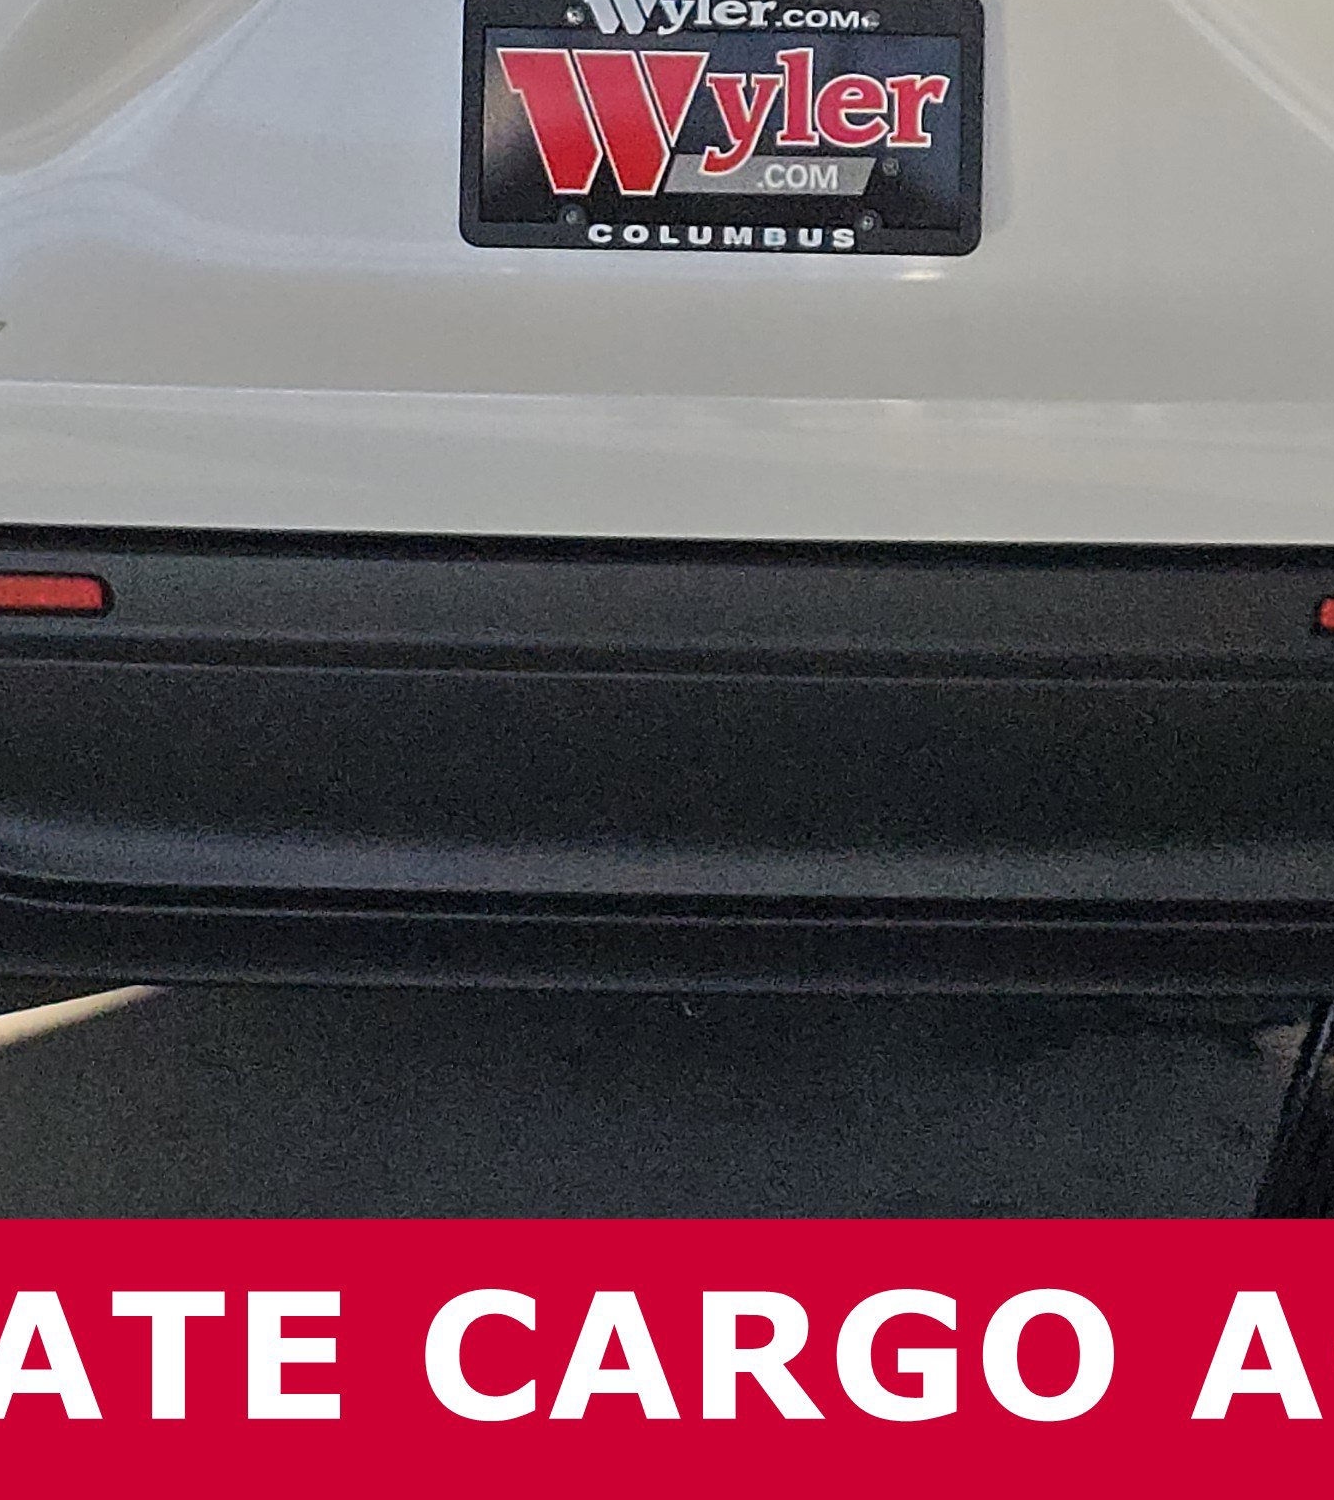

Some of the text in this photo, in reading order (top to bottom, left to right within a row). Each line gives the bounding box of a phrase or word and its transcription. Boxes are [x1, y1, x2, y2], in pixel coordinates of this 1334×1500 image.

[496, 47, 951, 197] Wyler
[756, 164, 839, 191] .COM
[587, 223, 856, 248] COLUMBUS
